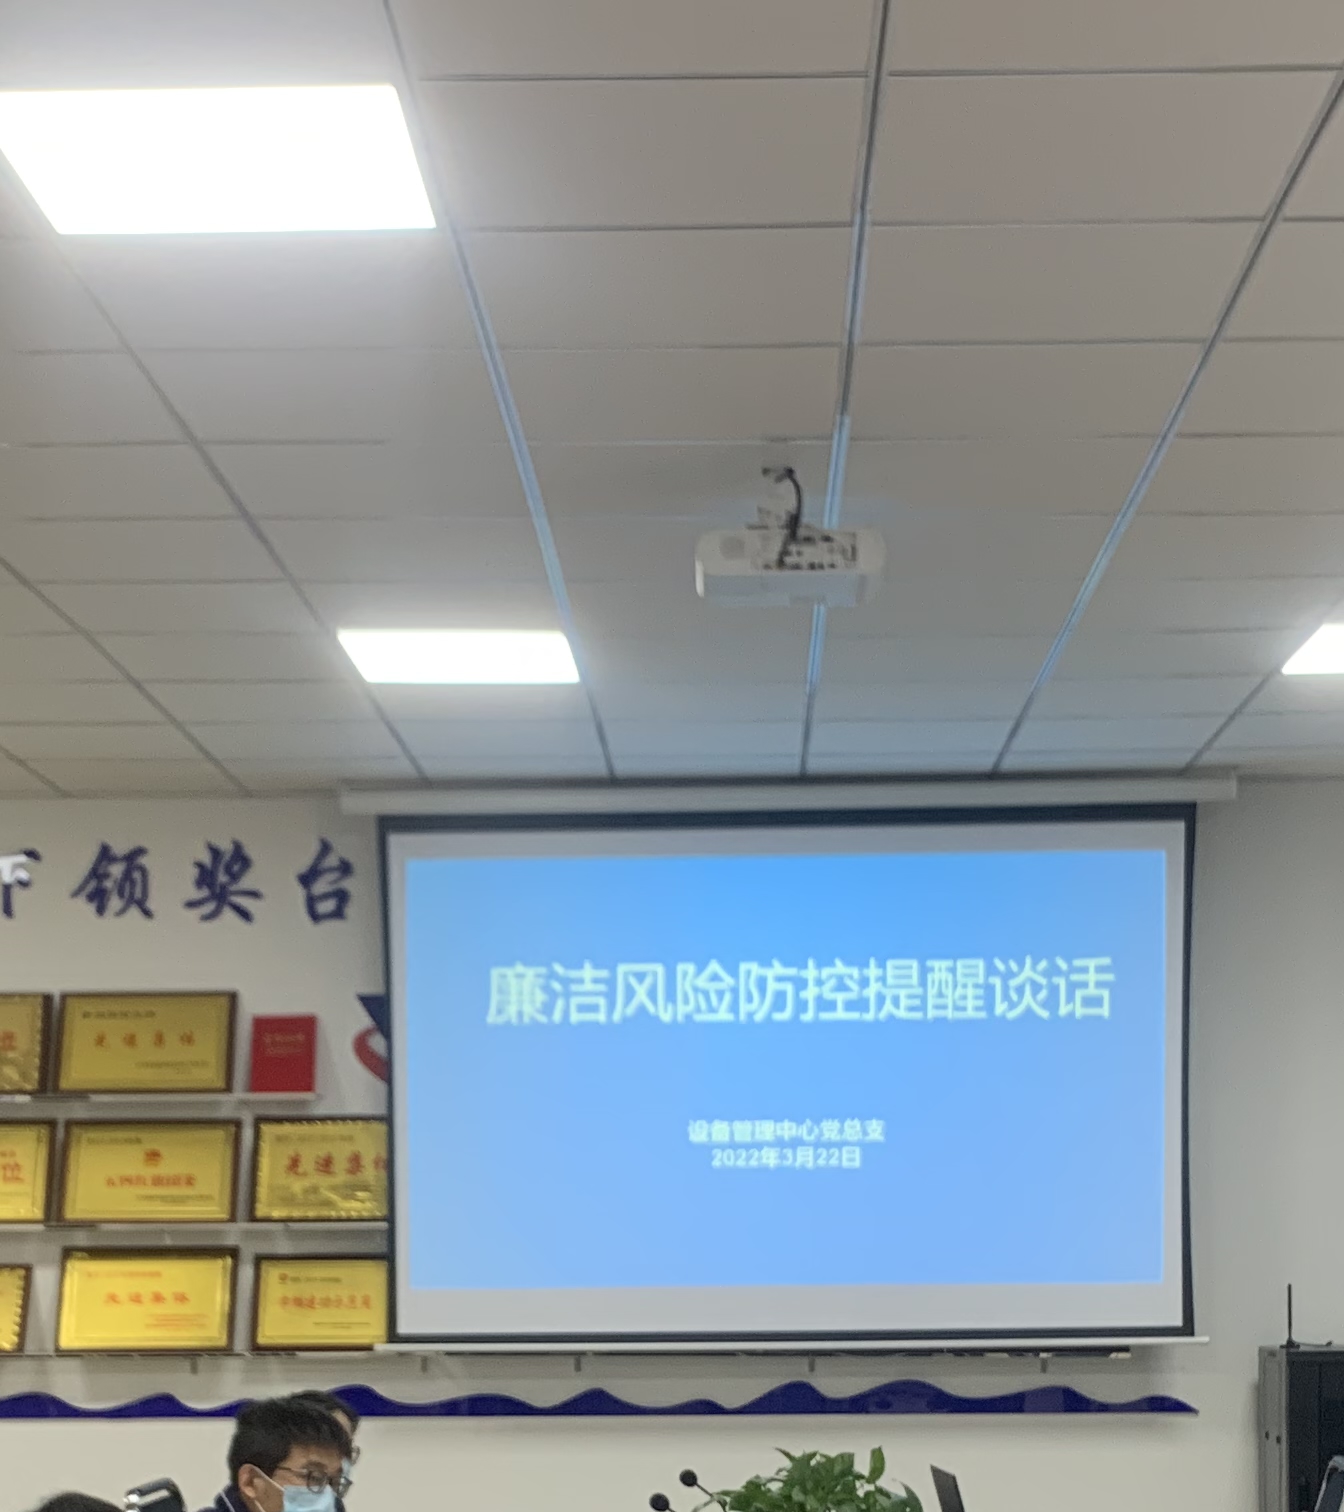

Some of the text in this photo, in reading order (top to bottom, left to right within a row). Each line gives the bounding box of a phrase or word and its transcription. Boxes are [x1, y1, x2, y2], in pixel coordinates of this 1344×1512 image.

[485, 954, 1116, 1027] 廉洁风险防控提醒谈话
[687, 1118, 887, 1144] 设备管理中心党总支
[710, 1146, 862, 1170] 2022年3月22日
